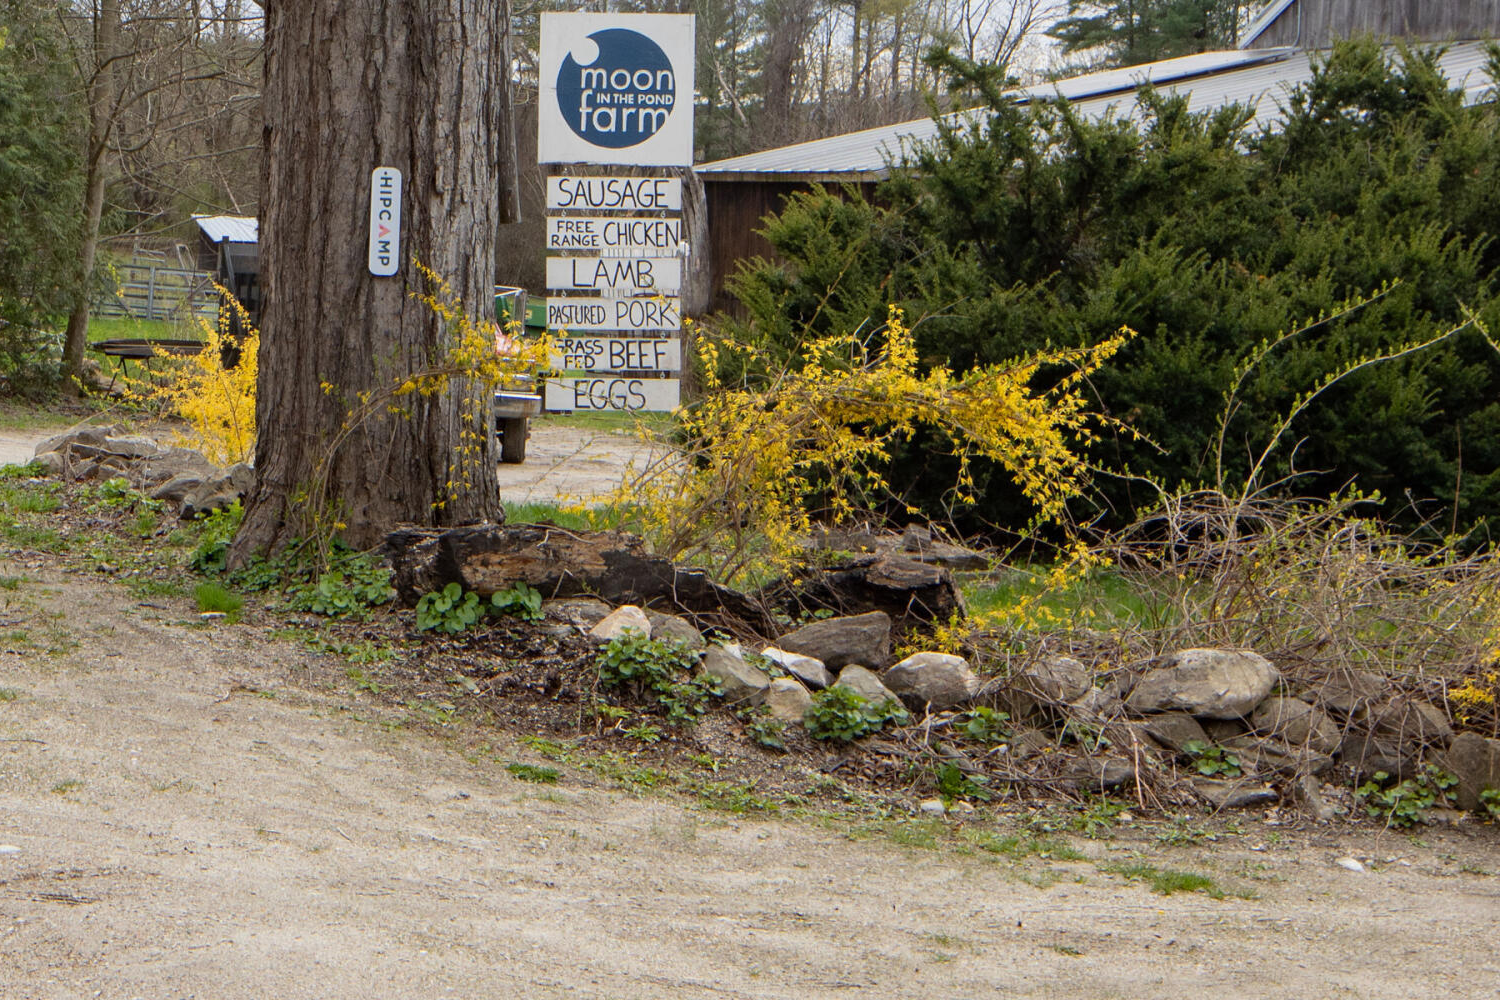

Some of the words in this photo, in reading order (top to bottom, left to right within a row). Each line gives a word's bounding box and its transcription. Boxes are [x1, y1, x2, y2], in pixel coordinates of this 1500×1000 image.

[581, 68, 673, 91] moon
[579, 89, 669, 133] farm
[597, 93, 607, 104] IN
[613, 93, 634, 105] THE
[638, 94, 673, 105] POND
[557, 178, 670, 208] SAUSAGE
[378, 176, 393, 266] HIPCAMP
[557, 220, 595, 233] FREE
[603, 221, 679, 247] CHICKEN
[551, 234, 600, 247] RANGE
[573, 259, 655, 288] LAMB
[549, 305, 606, 325] PASTURED
[616, 300, 675, 327] PORK
[564, 355, 596, 369] FED
[609, 340, 668, 370] BEEF
[574, 380, 646, 410] EGGS
